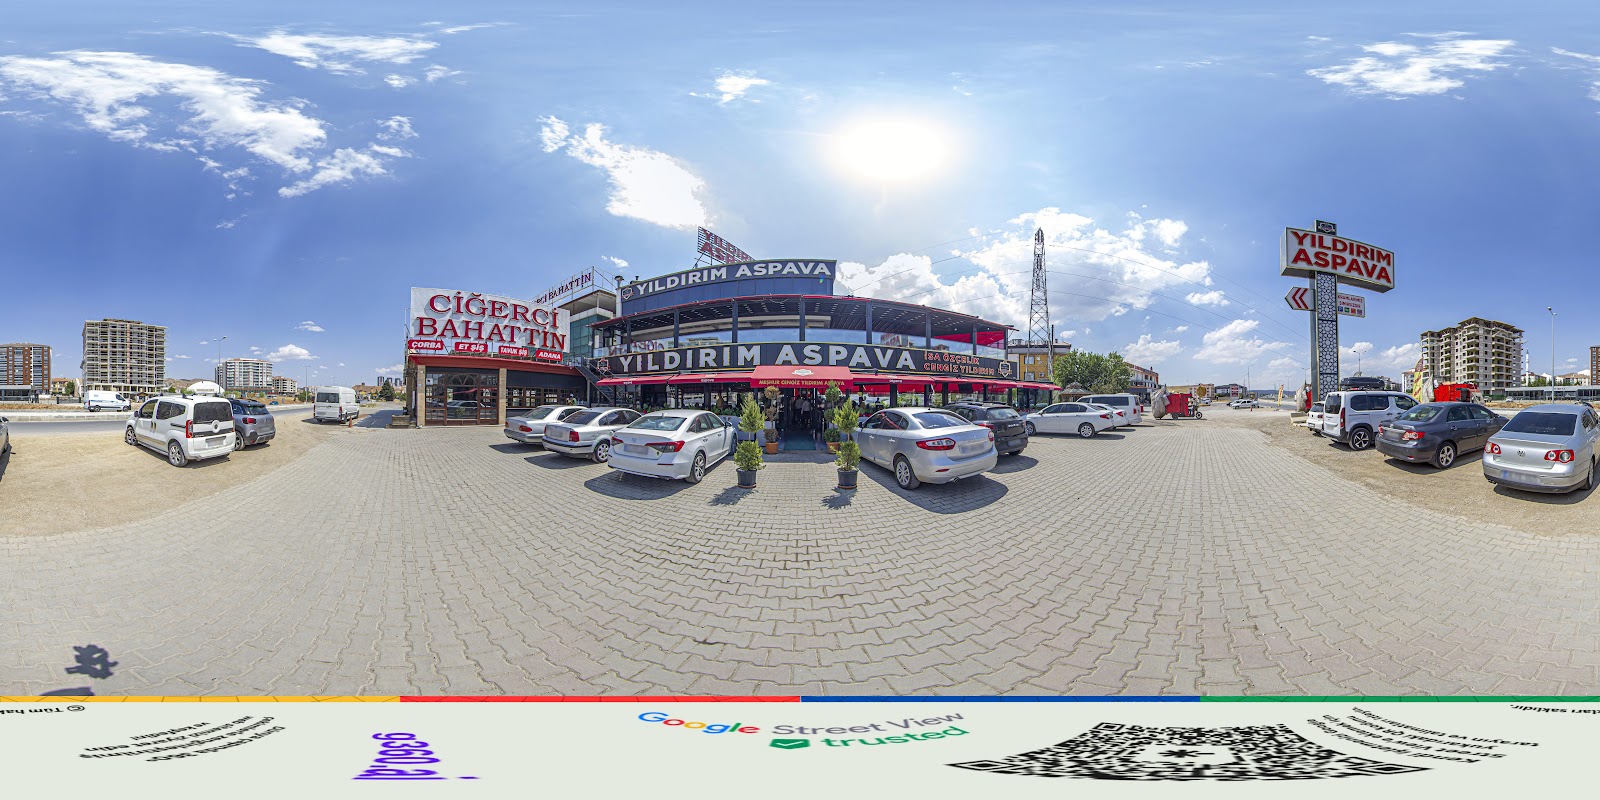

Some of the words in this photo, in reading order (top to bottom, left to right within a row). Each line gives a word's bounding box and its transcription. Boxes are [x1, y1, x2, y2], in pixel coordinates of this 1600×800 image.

[1290, 230, 1392, 266] YILDIRIM
[636, 266, 728, 296] YILDIRIM
[735, 262, 831, 278] ASPAVA
[1291, 248, 1392, 284] ASPAVA
[429, 290, 559, 328] CİĞERCİ
[411, 340, 442, 350] ÇORBA
[416, 316, 566, 350] BAHATTİN
[470, 343, 485, 352] ŞİŞ
[538, 351, 562, 360] ADANA
[619, 344, 761, 372] YILDIRIM
[775, 345, 916, 370] ASPAVA
[924, 362, 958, 373] CENGİZ
